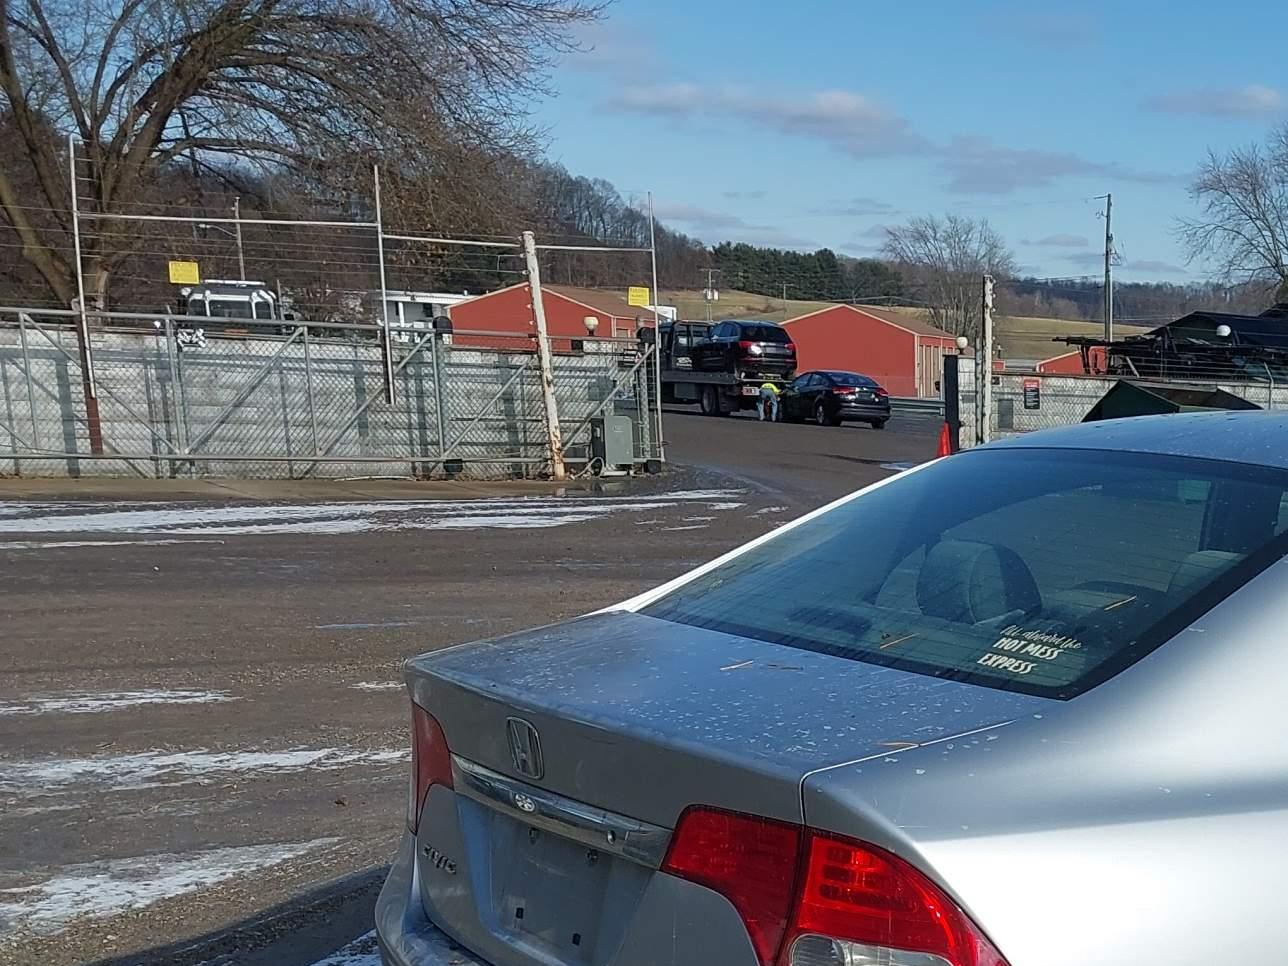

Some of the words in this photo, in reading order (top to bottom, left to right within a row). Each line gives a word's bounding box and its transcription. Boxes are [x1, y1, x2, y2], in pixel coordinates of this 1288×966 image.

[992, 637, 1028, 652] HOT
[1020, 643, 1064, 661] MESS
[977, 652, 1039, 675] EXPRESS
